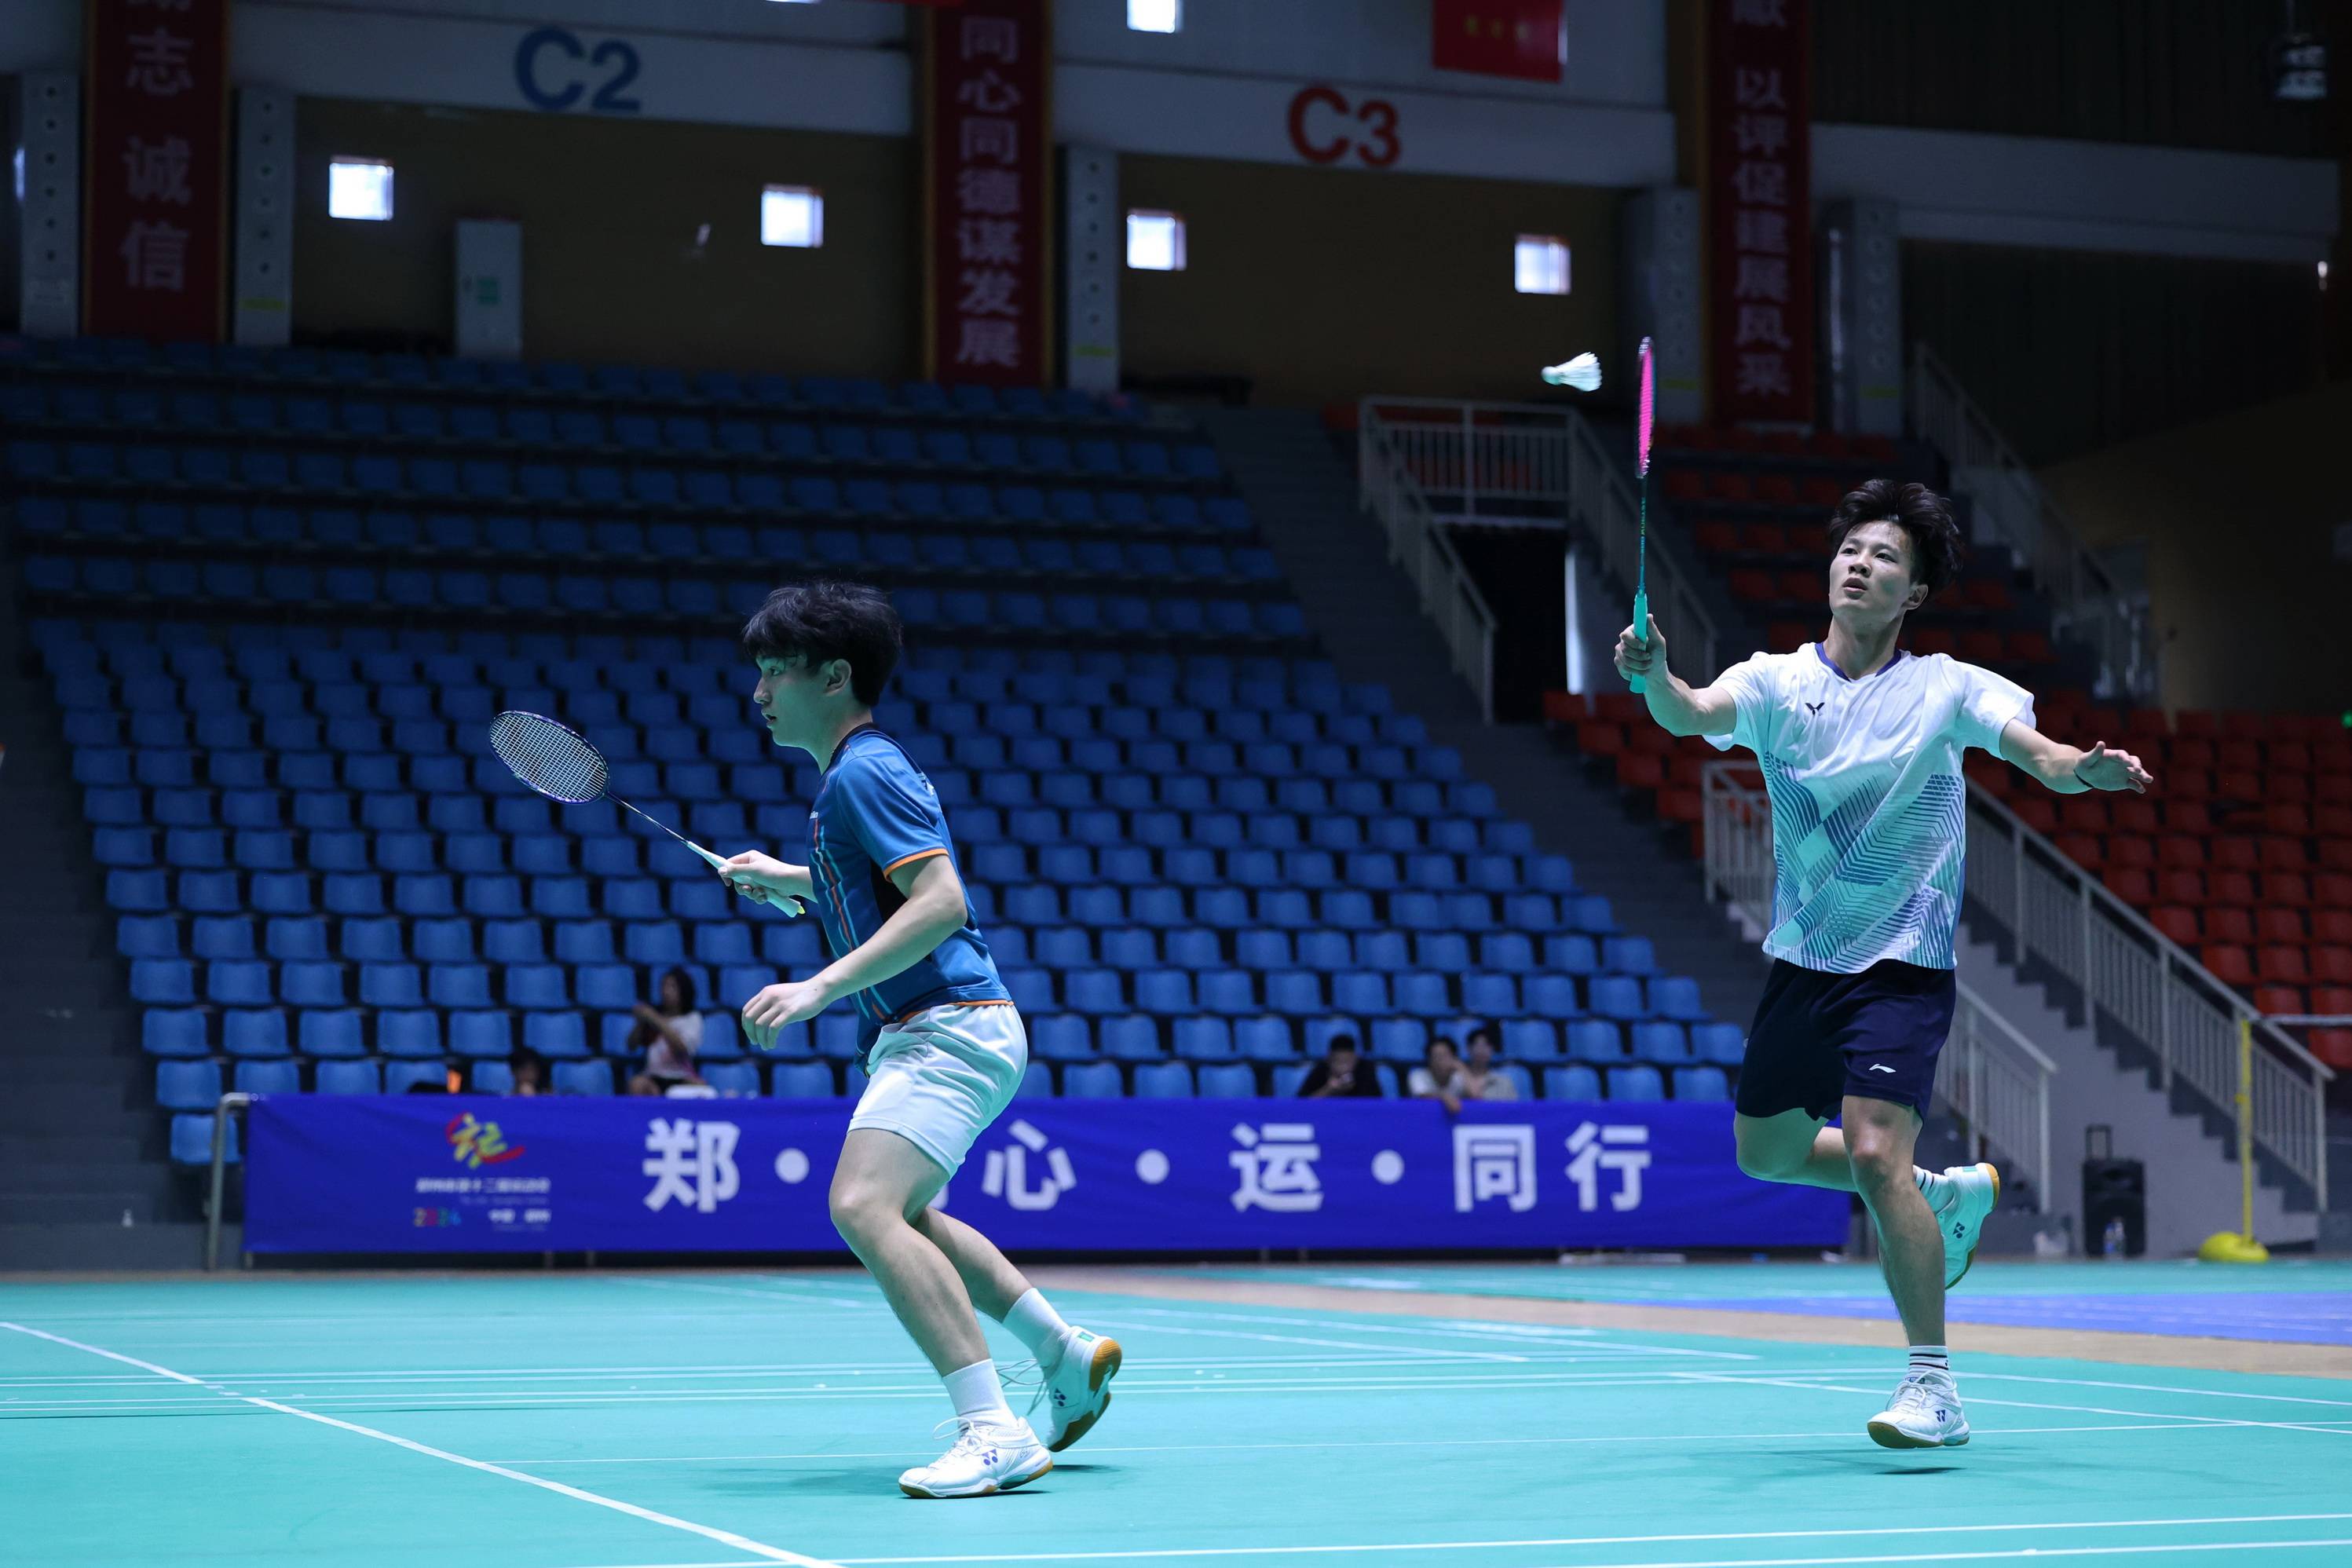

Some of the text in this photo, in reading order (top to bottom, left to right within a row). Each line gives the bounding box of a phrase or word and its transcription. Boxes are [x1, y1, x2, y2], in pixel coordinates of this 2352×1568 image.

[516, 27, 640, 109] C2
[1289, 87, 1399, 167] C3
[955, 15, 1021, 367] 同心同德谋发展
